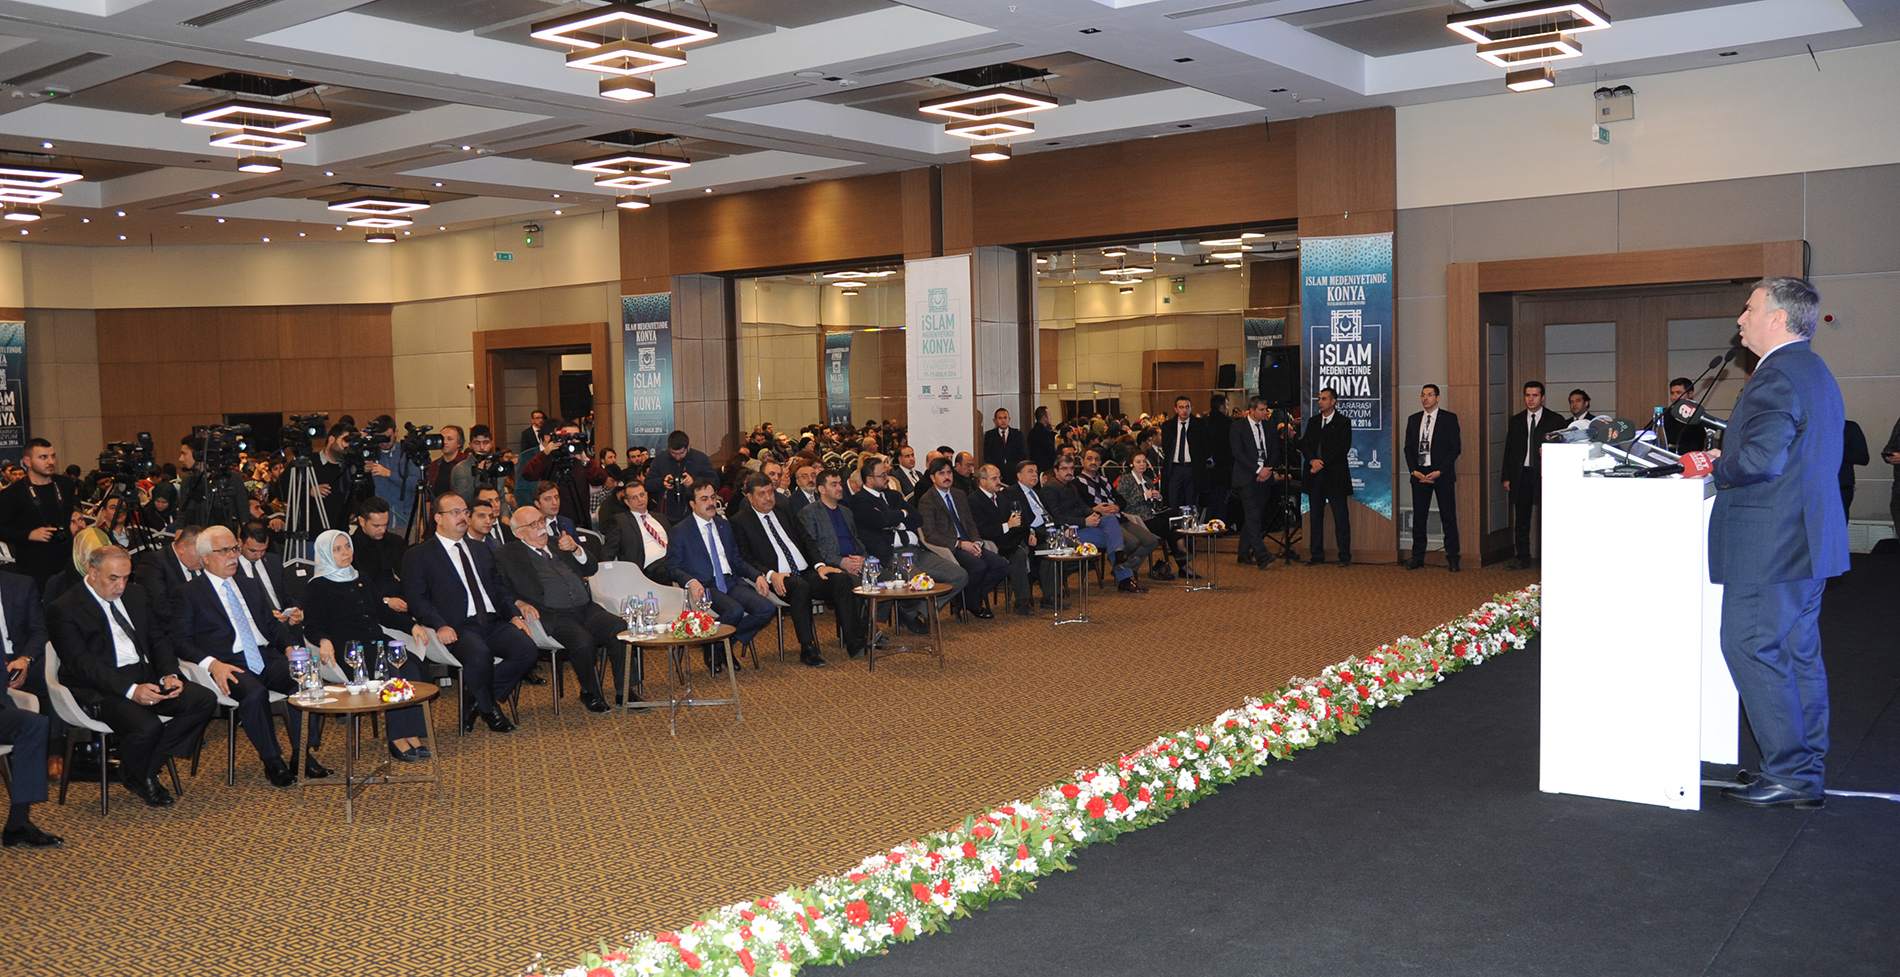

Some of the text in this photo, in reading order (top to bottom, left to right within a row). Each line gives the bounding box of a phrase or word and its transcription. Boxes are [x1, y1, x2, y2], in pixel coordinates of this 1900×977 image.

[1327, 286, 1366, 301] KONYA
[636, 330, 657, 342] KONYA
[922, 338, 955, 354] KONYA
[1320, 375, 1371, 396] KONYA
[633, 396, 662, 411] KONYA
[1358, 419, 1372, 427] 2016
[1695, 451, 1710, 469] TRT
